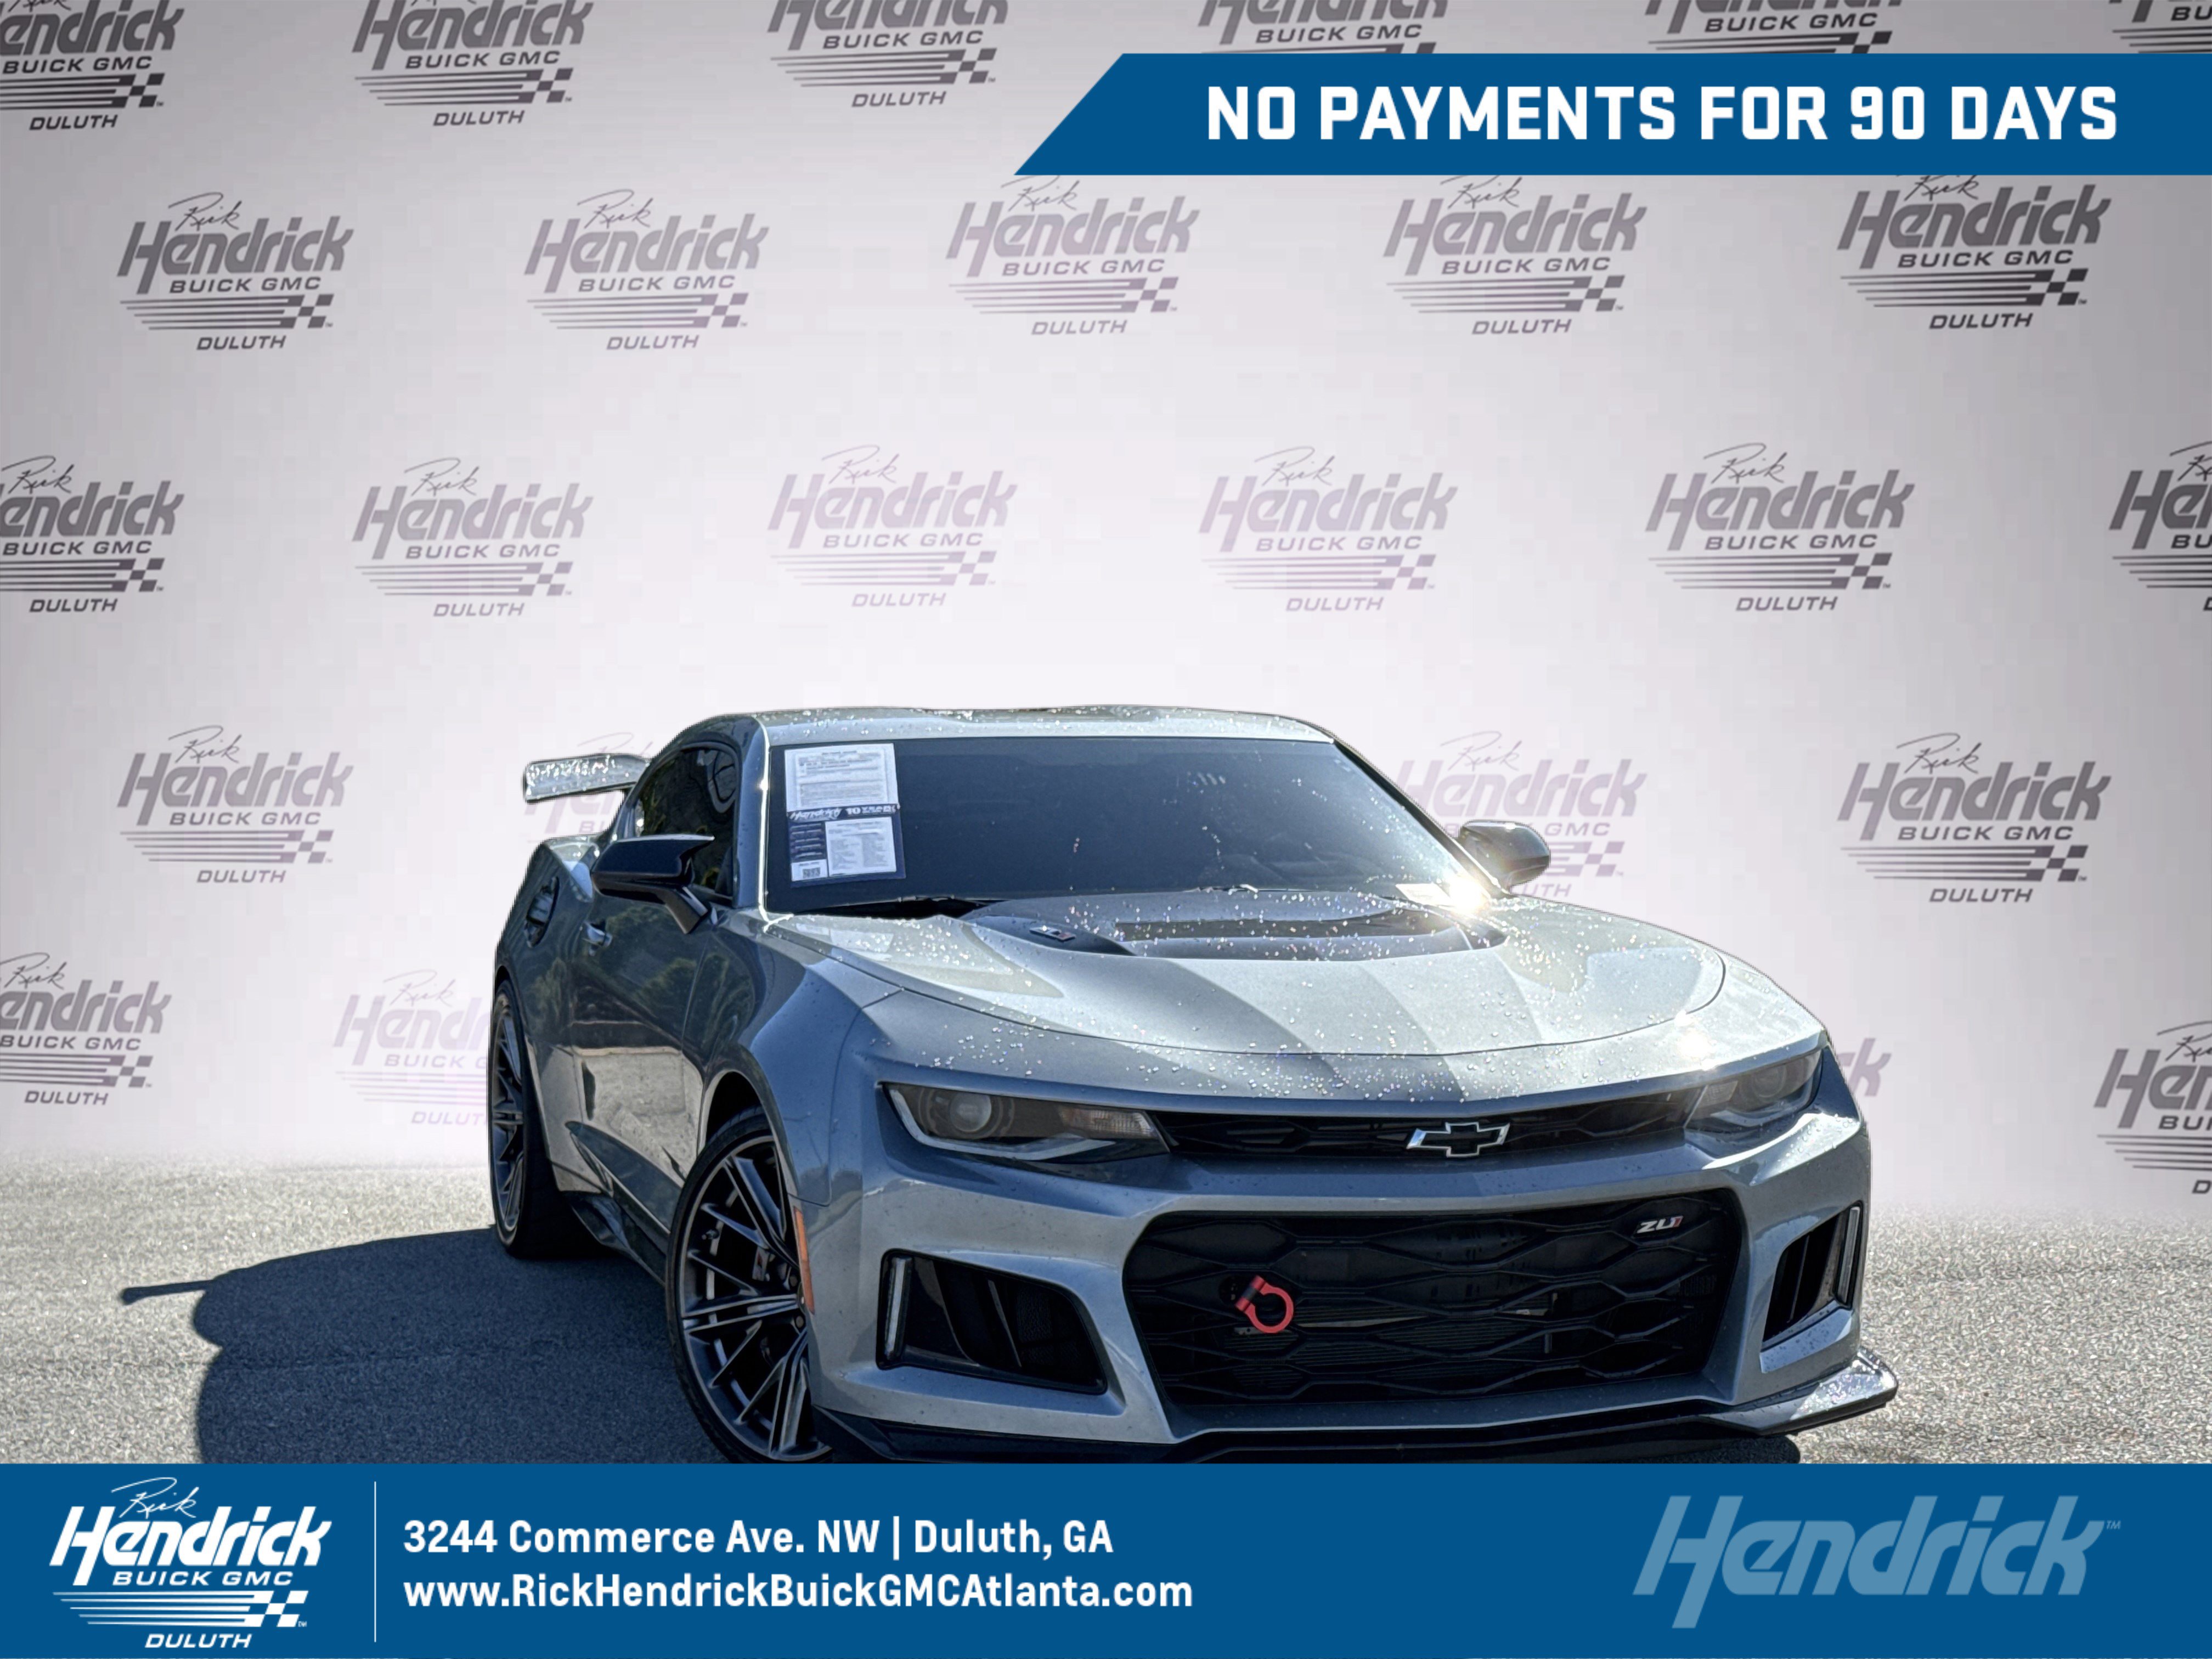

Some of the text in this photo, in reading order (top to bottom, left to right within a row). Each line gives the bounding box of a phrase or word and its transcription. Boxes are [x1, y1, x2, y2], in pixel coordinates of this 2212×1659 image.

[0, 0, 184, 56] endrick
[1705, 15, 1798, 32] BUICK
[1810, 13, 1877, 28] GMC
[352, 0, 593, 70] Hendrick
[823, 31, 983, 49] BUICK GMC
[1256, 25, 1421, 43] BUICK GMC
[3, 57, 151, 74] BUICK GMC
[405, 51, 560, 69] BUICK GMC
[852, 91, 946, 107] DULUTH
[30, 115, 117, 130] DULUTH
[433, 110, 524, 126] DULUTH
[1384, 191, 1647, 274] Hendrick
[1838, 182, 2112, 268] Hendrick
[946, 194, 1200, 276] Hendrick
[117, 214, 353, 295] Hendrick
[524, 212, 769, 293] Hendrick
[1898, 250, 2073, 268] BUICK GMC
[1002, 259, 1164, 275] BUICK GMC
[1442, 257, 1610, 274] BUICK GMC
[170, 277, 320, 293] BUICK GMC
[579, 275, 735, 292] BUICK GMC
[1031, 320, 1127, 335] DULUTH
[1472, 319, 1572, 334] DULUTH
[1930, 313, 2033, 329] DULUTH
[197, 336, 286, 350] DULUTH
[607, 335, 699, 349] DULUTH
[0, 479, 184, 538] endrick
[768, 469, 1017, 549] Hendrick
[1200, 471, 1458, 551] Hendrick
[1647, 468, 1915, 550] Hendrick
[352, 481, 592, 560] Hendrick
[3, 541, 151, 555] BUICK GMC
[823, 533, 983, 548] BUICK GMC
[1256, 536, 1421, 551] BUICK GMC
[1706, 534, 1877, 550] BUICK GMC
[406, 544, 560, 559] BUICK GMC
[30, 599, 117, 612] DULUTH
[852, 593, 946, 607] DULUTH
[1286, 597, 1384, 611] DULUTH
[1736, 596, 1838, 611] DULUTH
[433, 603, 524, 617] DULUTH
[117, 750, 352, 826] Hendrick
[1393, 758, 1647, 819] Hendrick
[1839, 760, 2112, 840] Hendrick
[170, 812, 320, 825] BUICK GMC
[1545, 822, 1610, 836] GMC
[1898, 826, 2073, 840] BUICK GMC
[197, 870, 286, 883] DULUTH
[1930, 889, 2033, 902] DULUTH
[0, 978, 170, 1032] endrick
[0, 1035, 140, 1050] BUICK GMC
[384, 1054, 464, 1068] BUICK
[25, 1091, 108, 1104] DULUTH
[411, 1111, 487, 1126] DULUT
